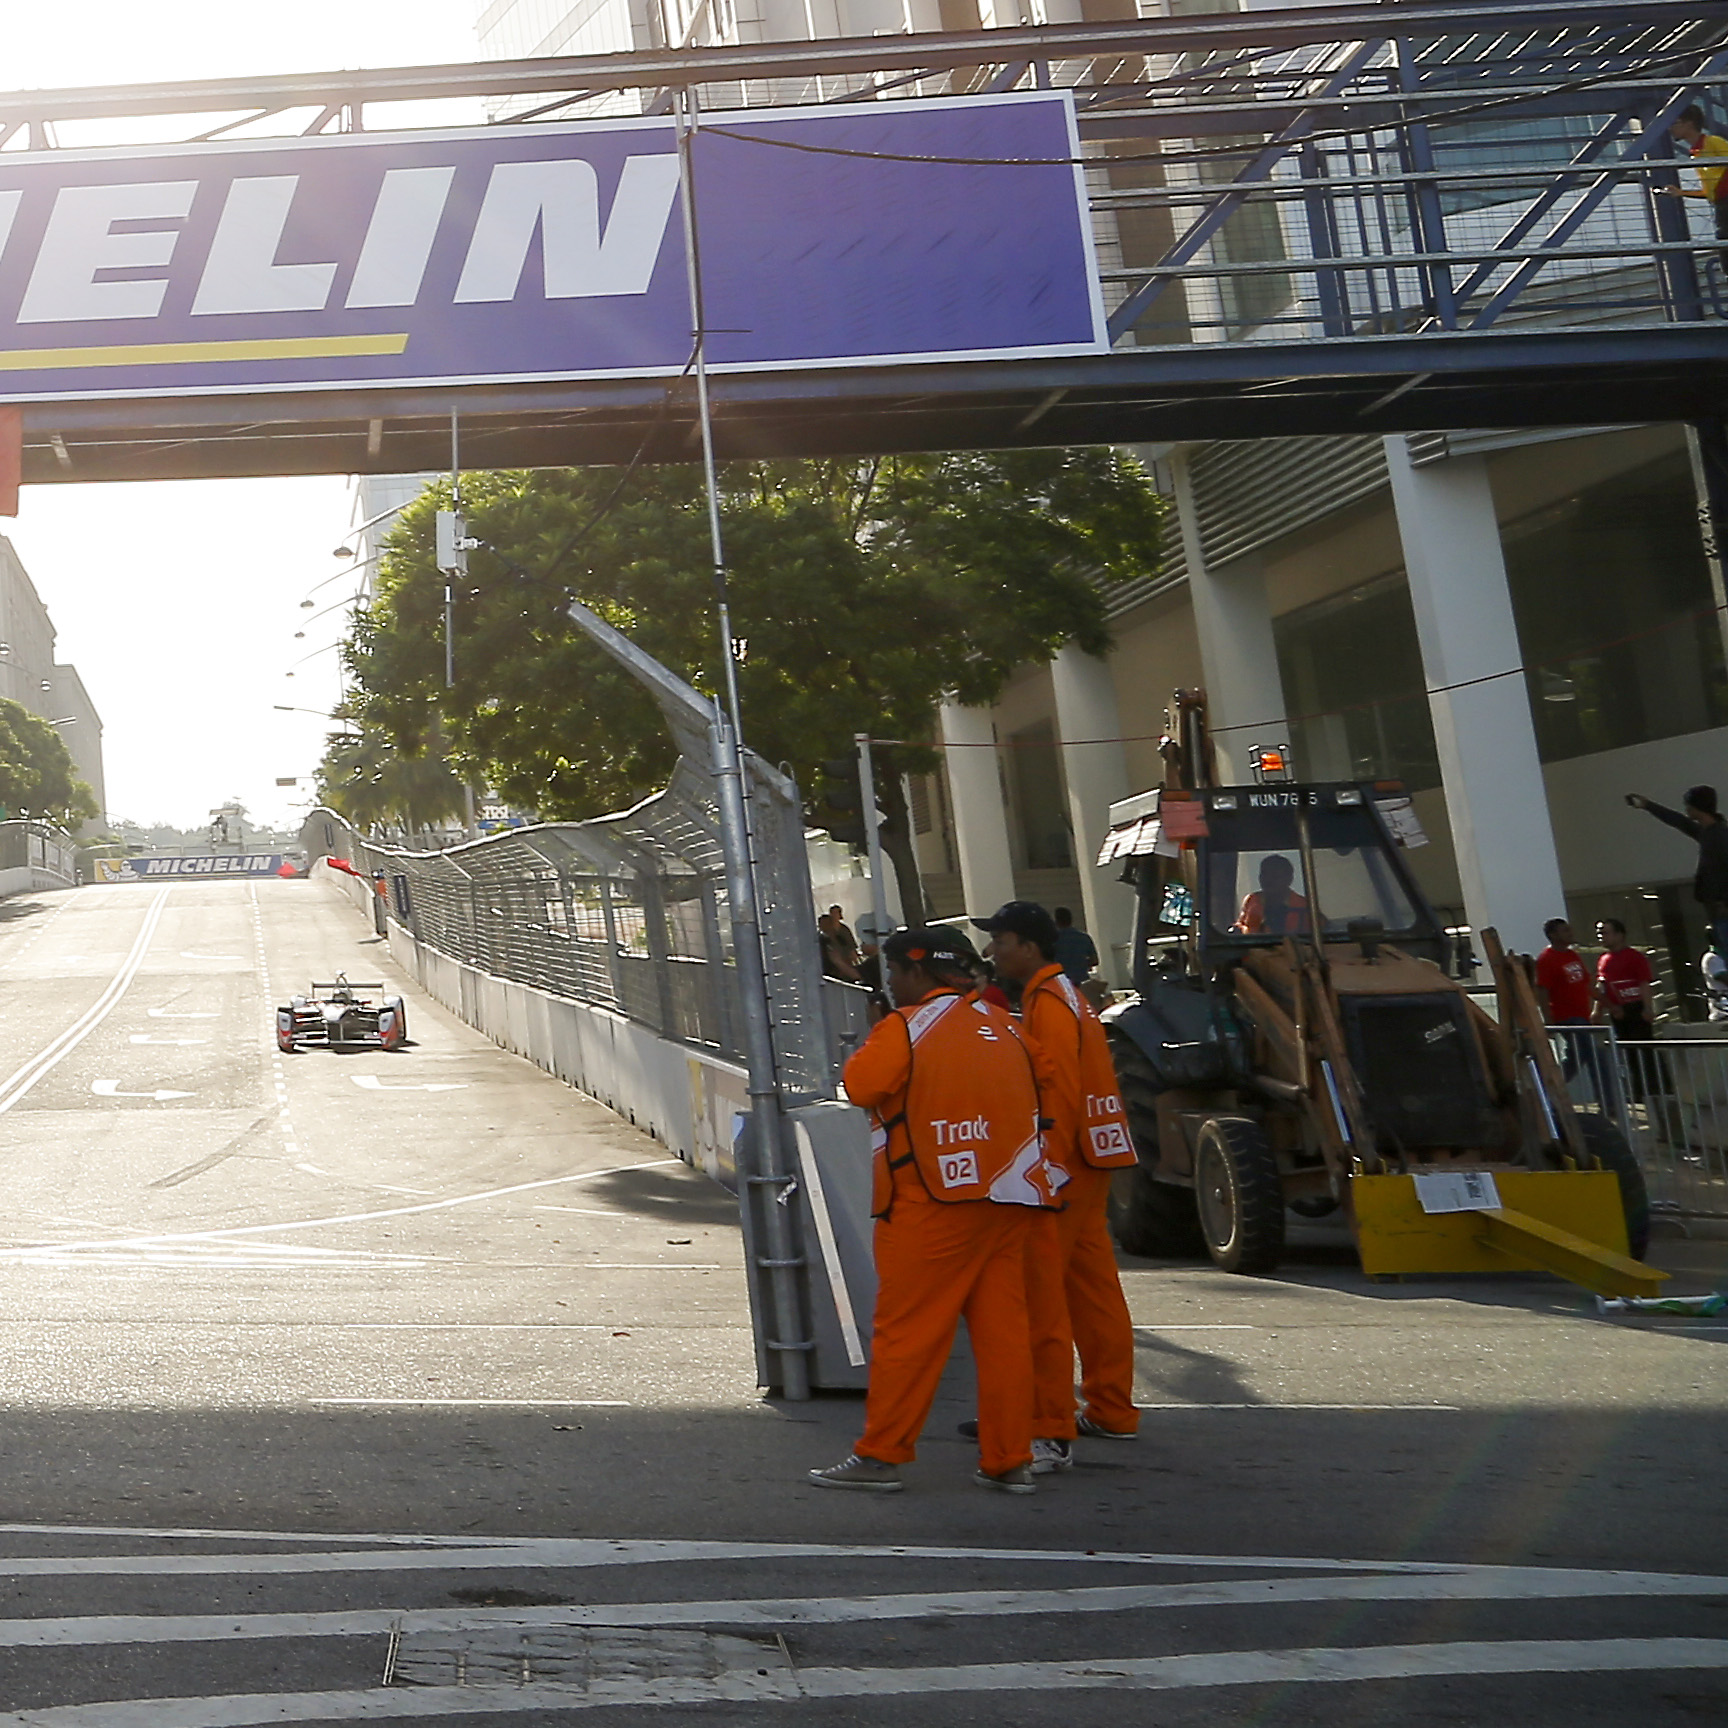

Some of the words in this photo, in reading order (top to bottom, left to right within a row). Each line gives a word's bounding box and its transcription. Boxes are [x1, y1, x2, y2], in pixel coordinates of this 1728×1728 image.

[146, 856, 272, 874] MICHELIN
[930, 1114, 990, 1145] Track
[1096, 1129, 1122, 1150] 02
[946, 1158, 971, 1180] 02
